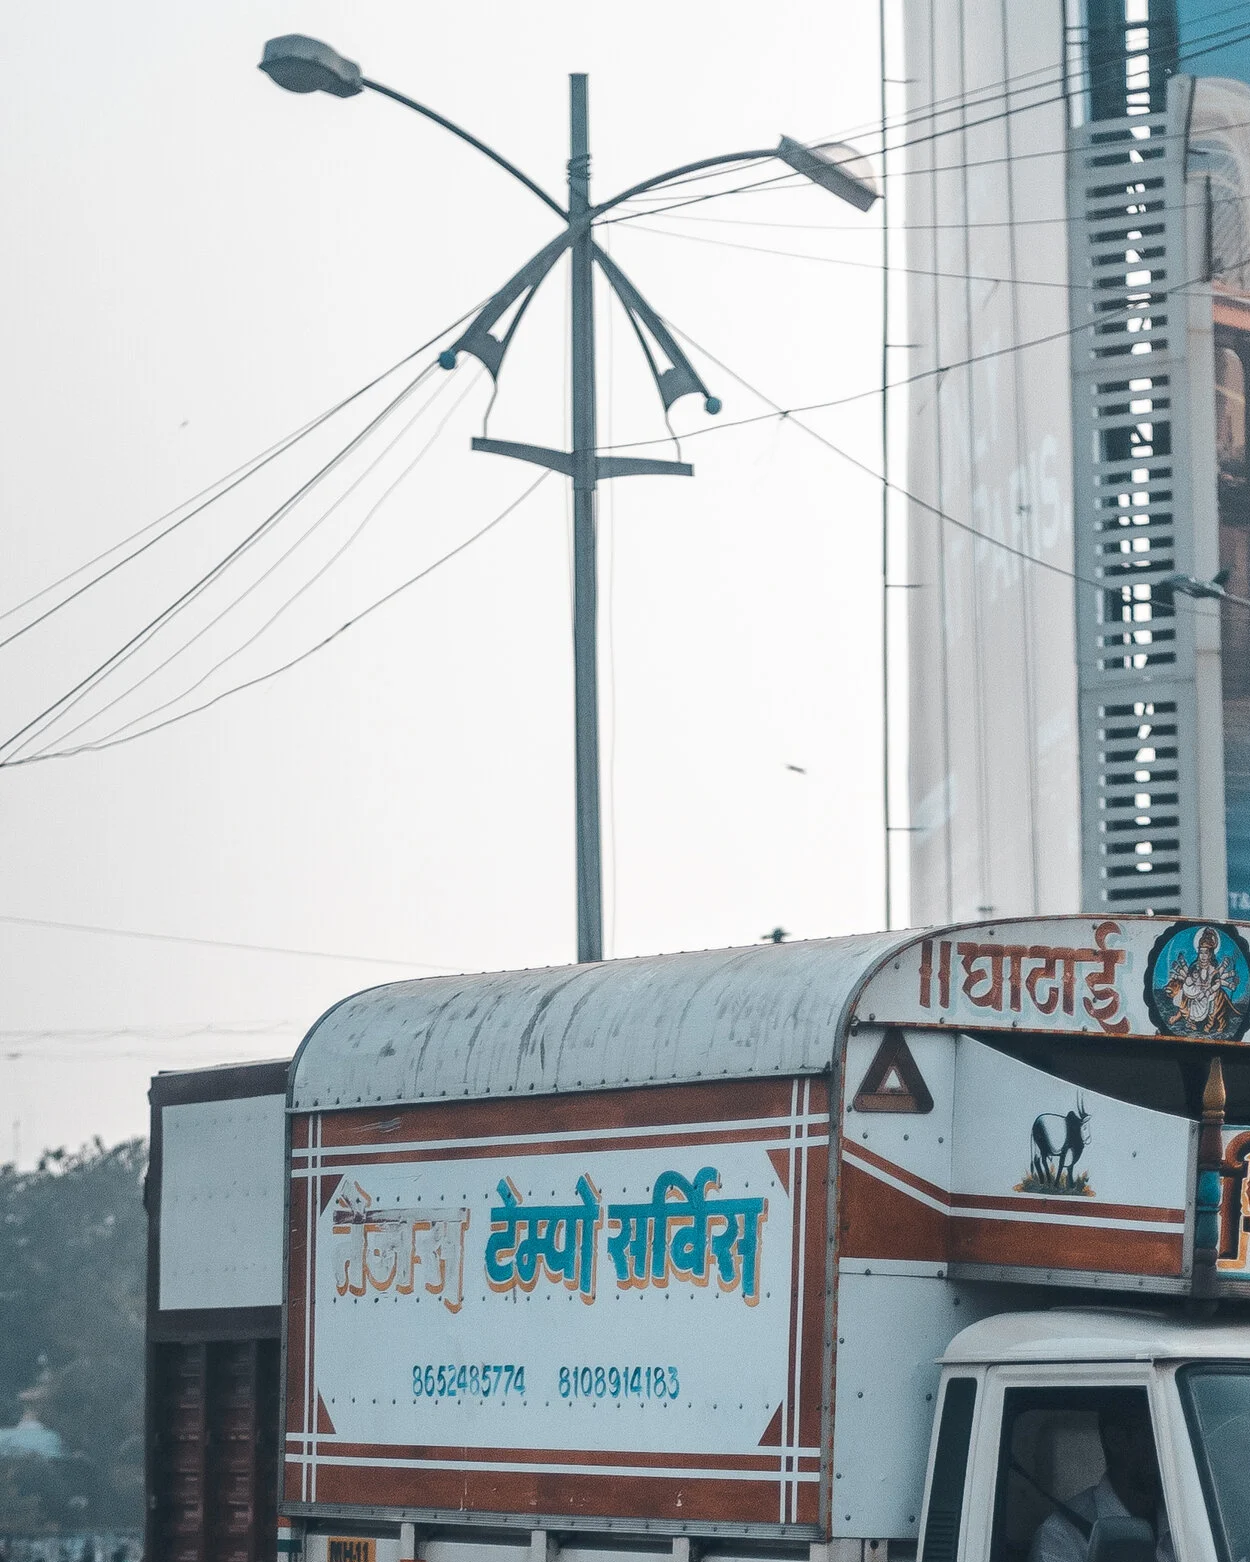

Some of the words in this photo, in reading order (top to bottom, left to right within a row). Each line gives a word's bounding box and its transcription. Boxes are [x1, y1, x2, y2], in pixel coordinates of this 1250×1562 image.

[485, 1173, 601, 1306] टेम्पो
[606, 1166, 768, 1306] सर्विस
[412, 1364, 526, 1398] 8652485774
[559, 1365, 680, 1399] 8108914183
